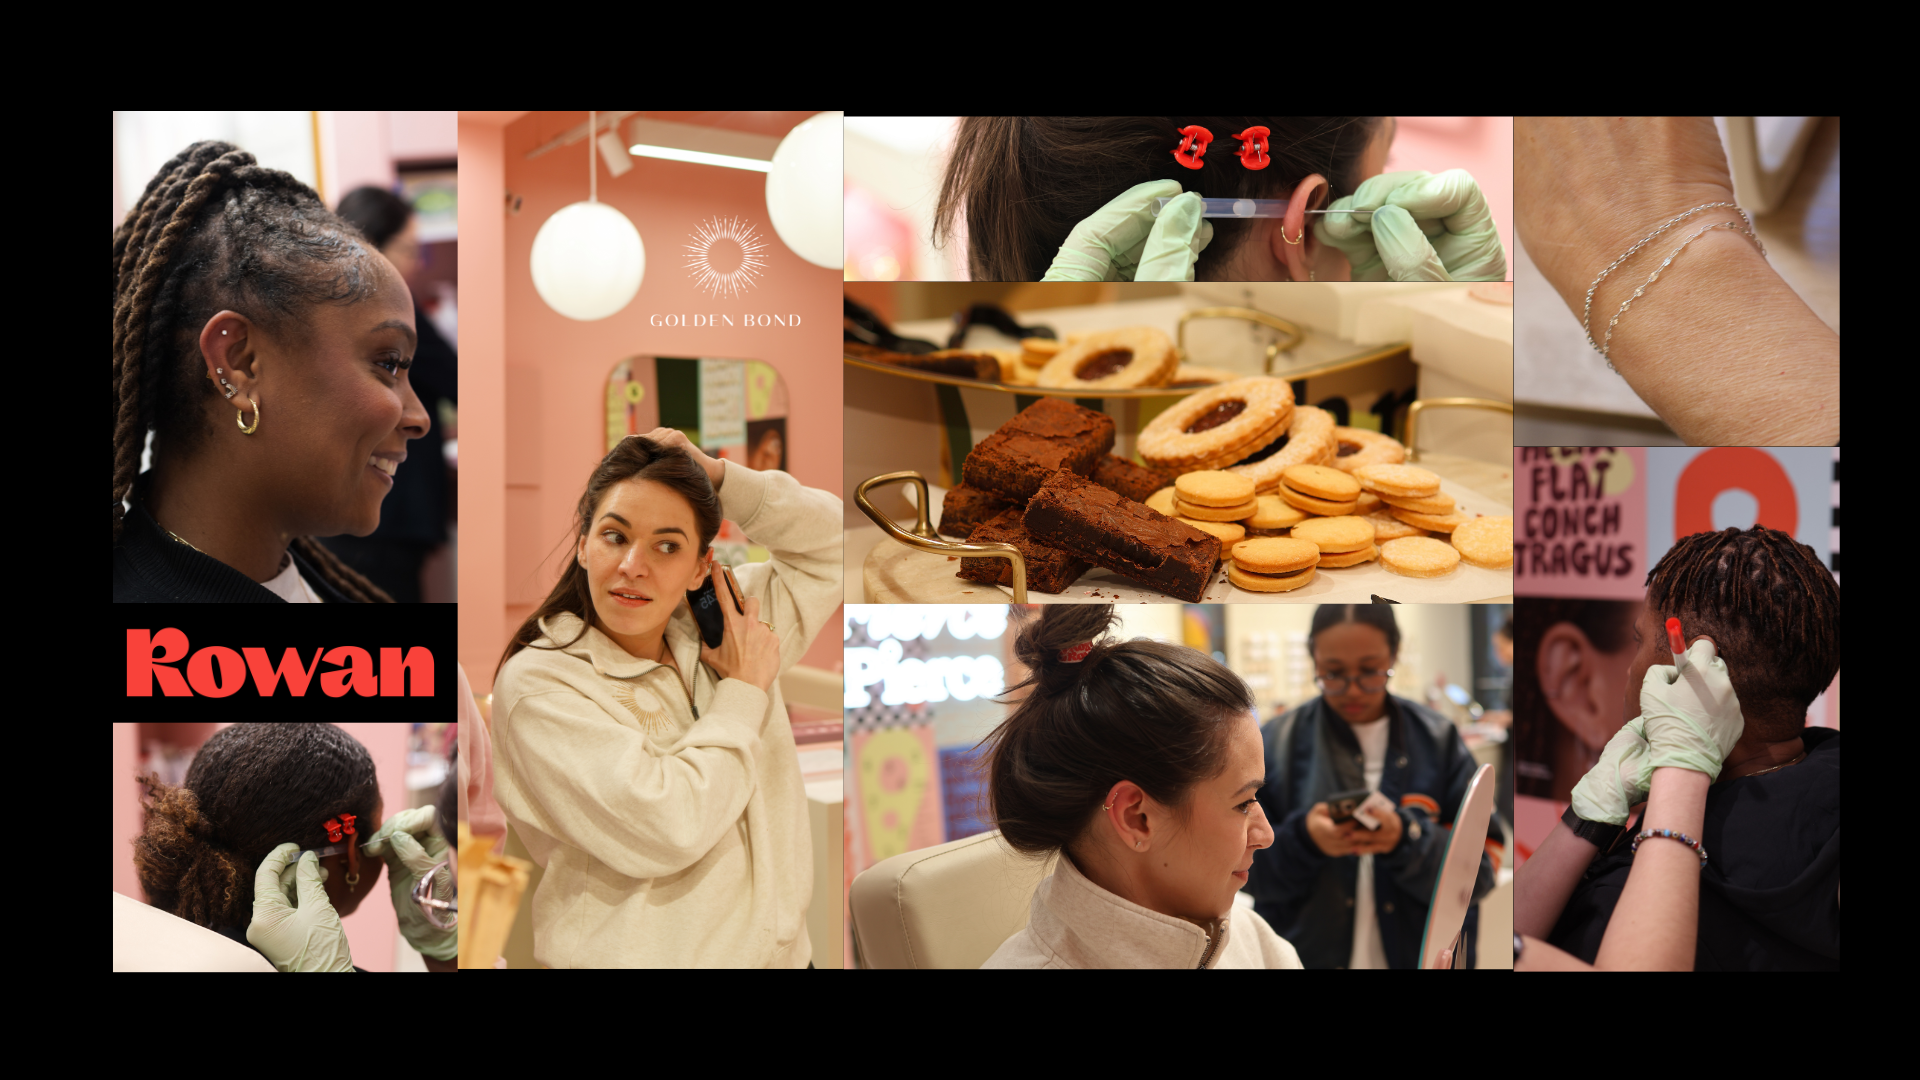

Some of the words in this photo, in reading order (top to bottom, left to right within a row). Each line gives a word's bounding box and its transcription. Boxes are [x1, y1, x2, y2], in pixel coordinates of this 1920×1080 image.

[1531, 461, 1611, 503] FLAT
[1525, 503, 1621, 539] CONCH
[1514, 541, 1635, 578] TRAGUS
